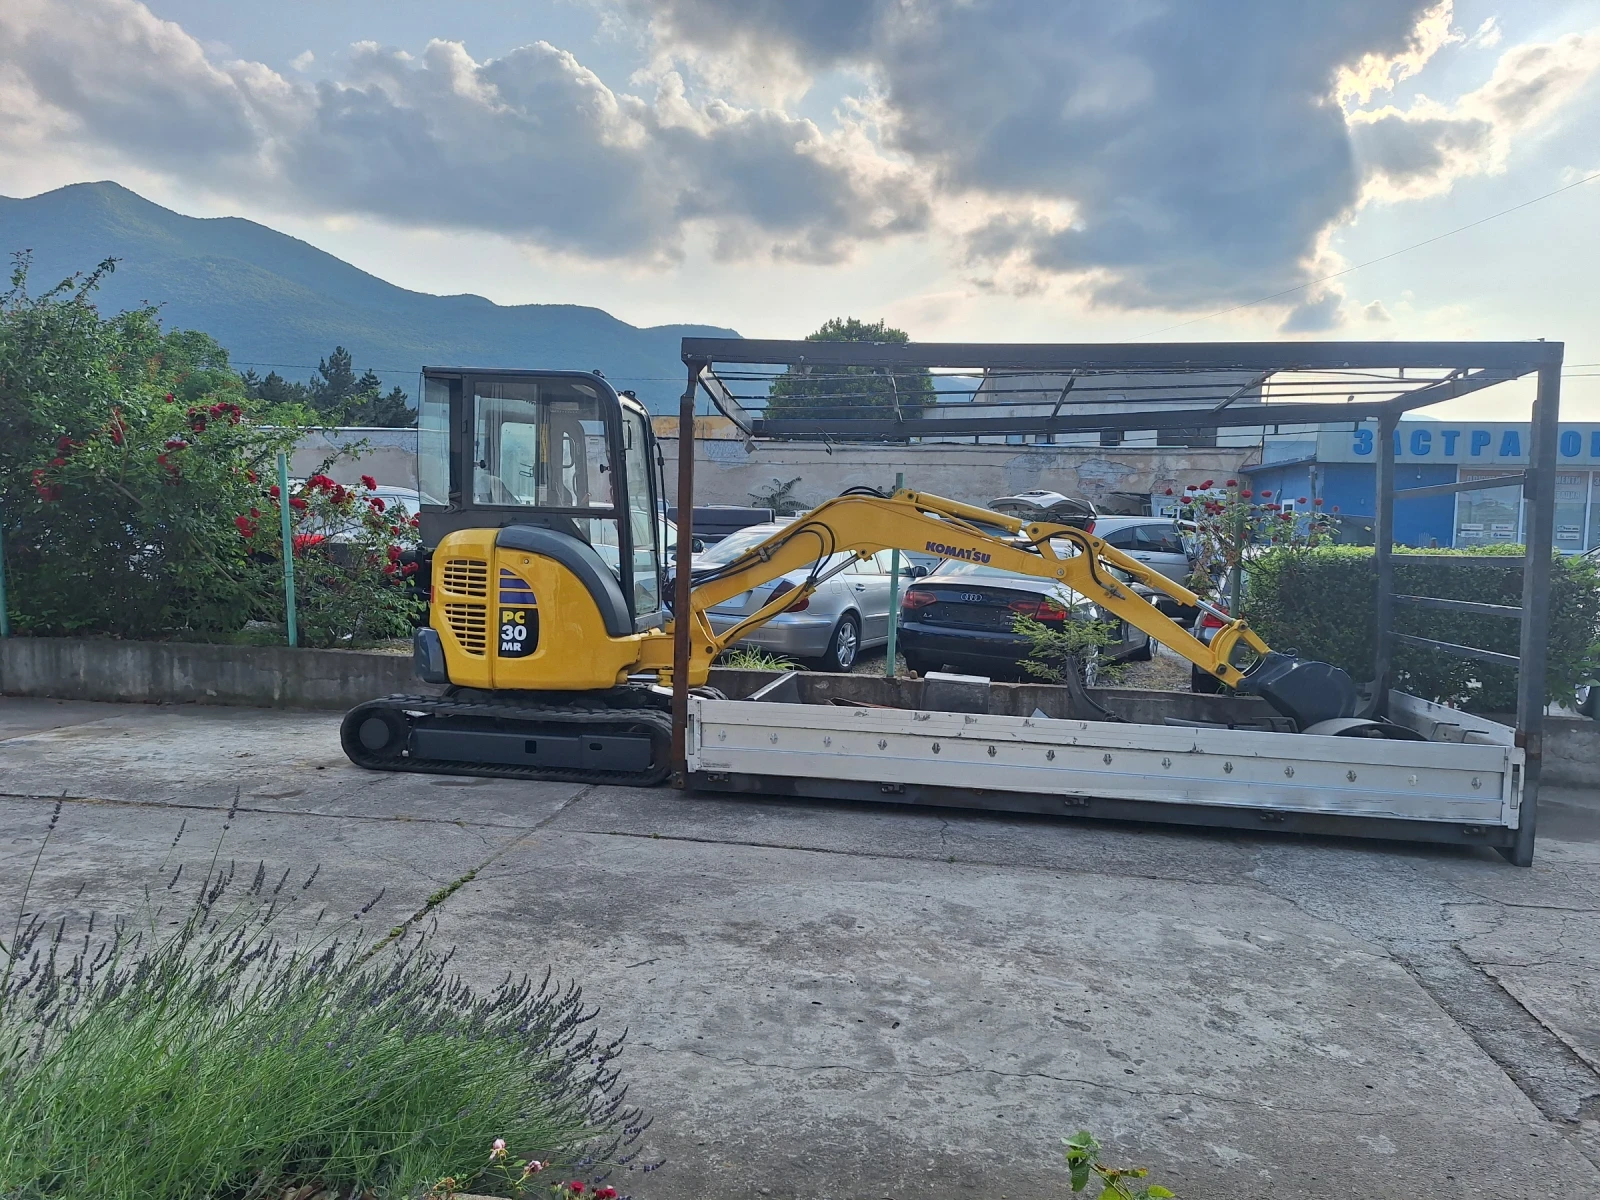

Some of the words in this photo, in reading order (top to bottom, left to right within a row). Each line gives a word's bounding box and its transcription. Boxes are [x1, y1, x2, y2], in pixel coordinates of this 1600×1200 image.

[1353, 430, 1600, 457] ЗСТРАО
[925, 541, 991, 564] KOMATSU
[502, 611, 525, 623] PC
[501, 625, 527, 640] 30
[501, 642, 522, 651] MR
